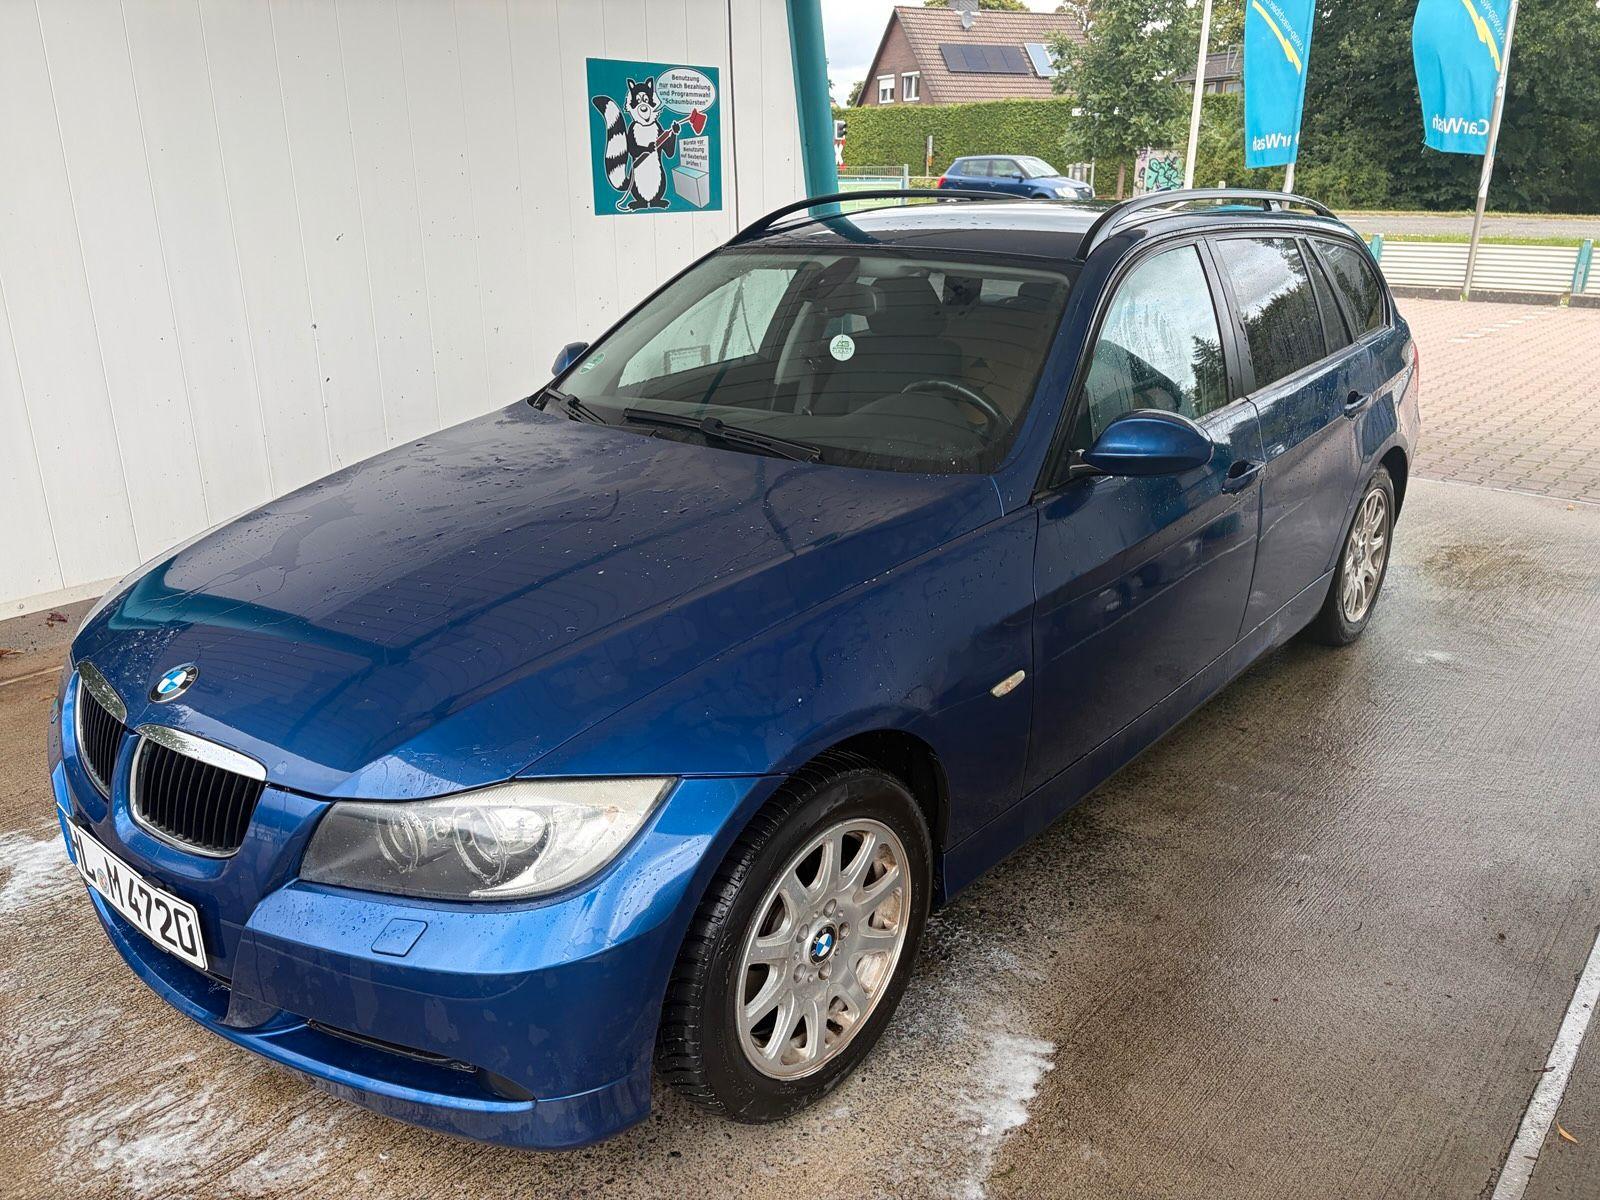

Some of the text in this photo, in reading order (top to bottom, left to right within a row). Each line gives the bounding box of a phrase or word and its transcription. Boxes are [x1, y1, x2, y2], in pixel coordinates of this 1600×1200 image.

[672, 74, 699, 83] Benutzung
[684, 83, 710, 91] Bezahlung
[671, 90, 711, 98] Programmwahl
[67, 823, 198, 957] HL M 4720
